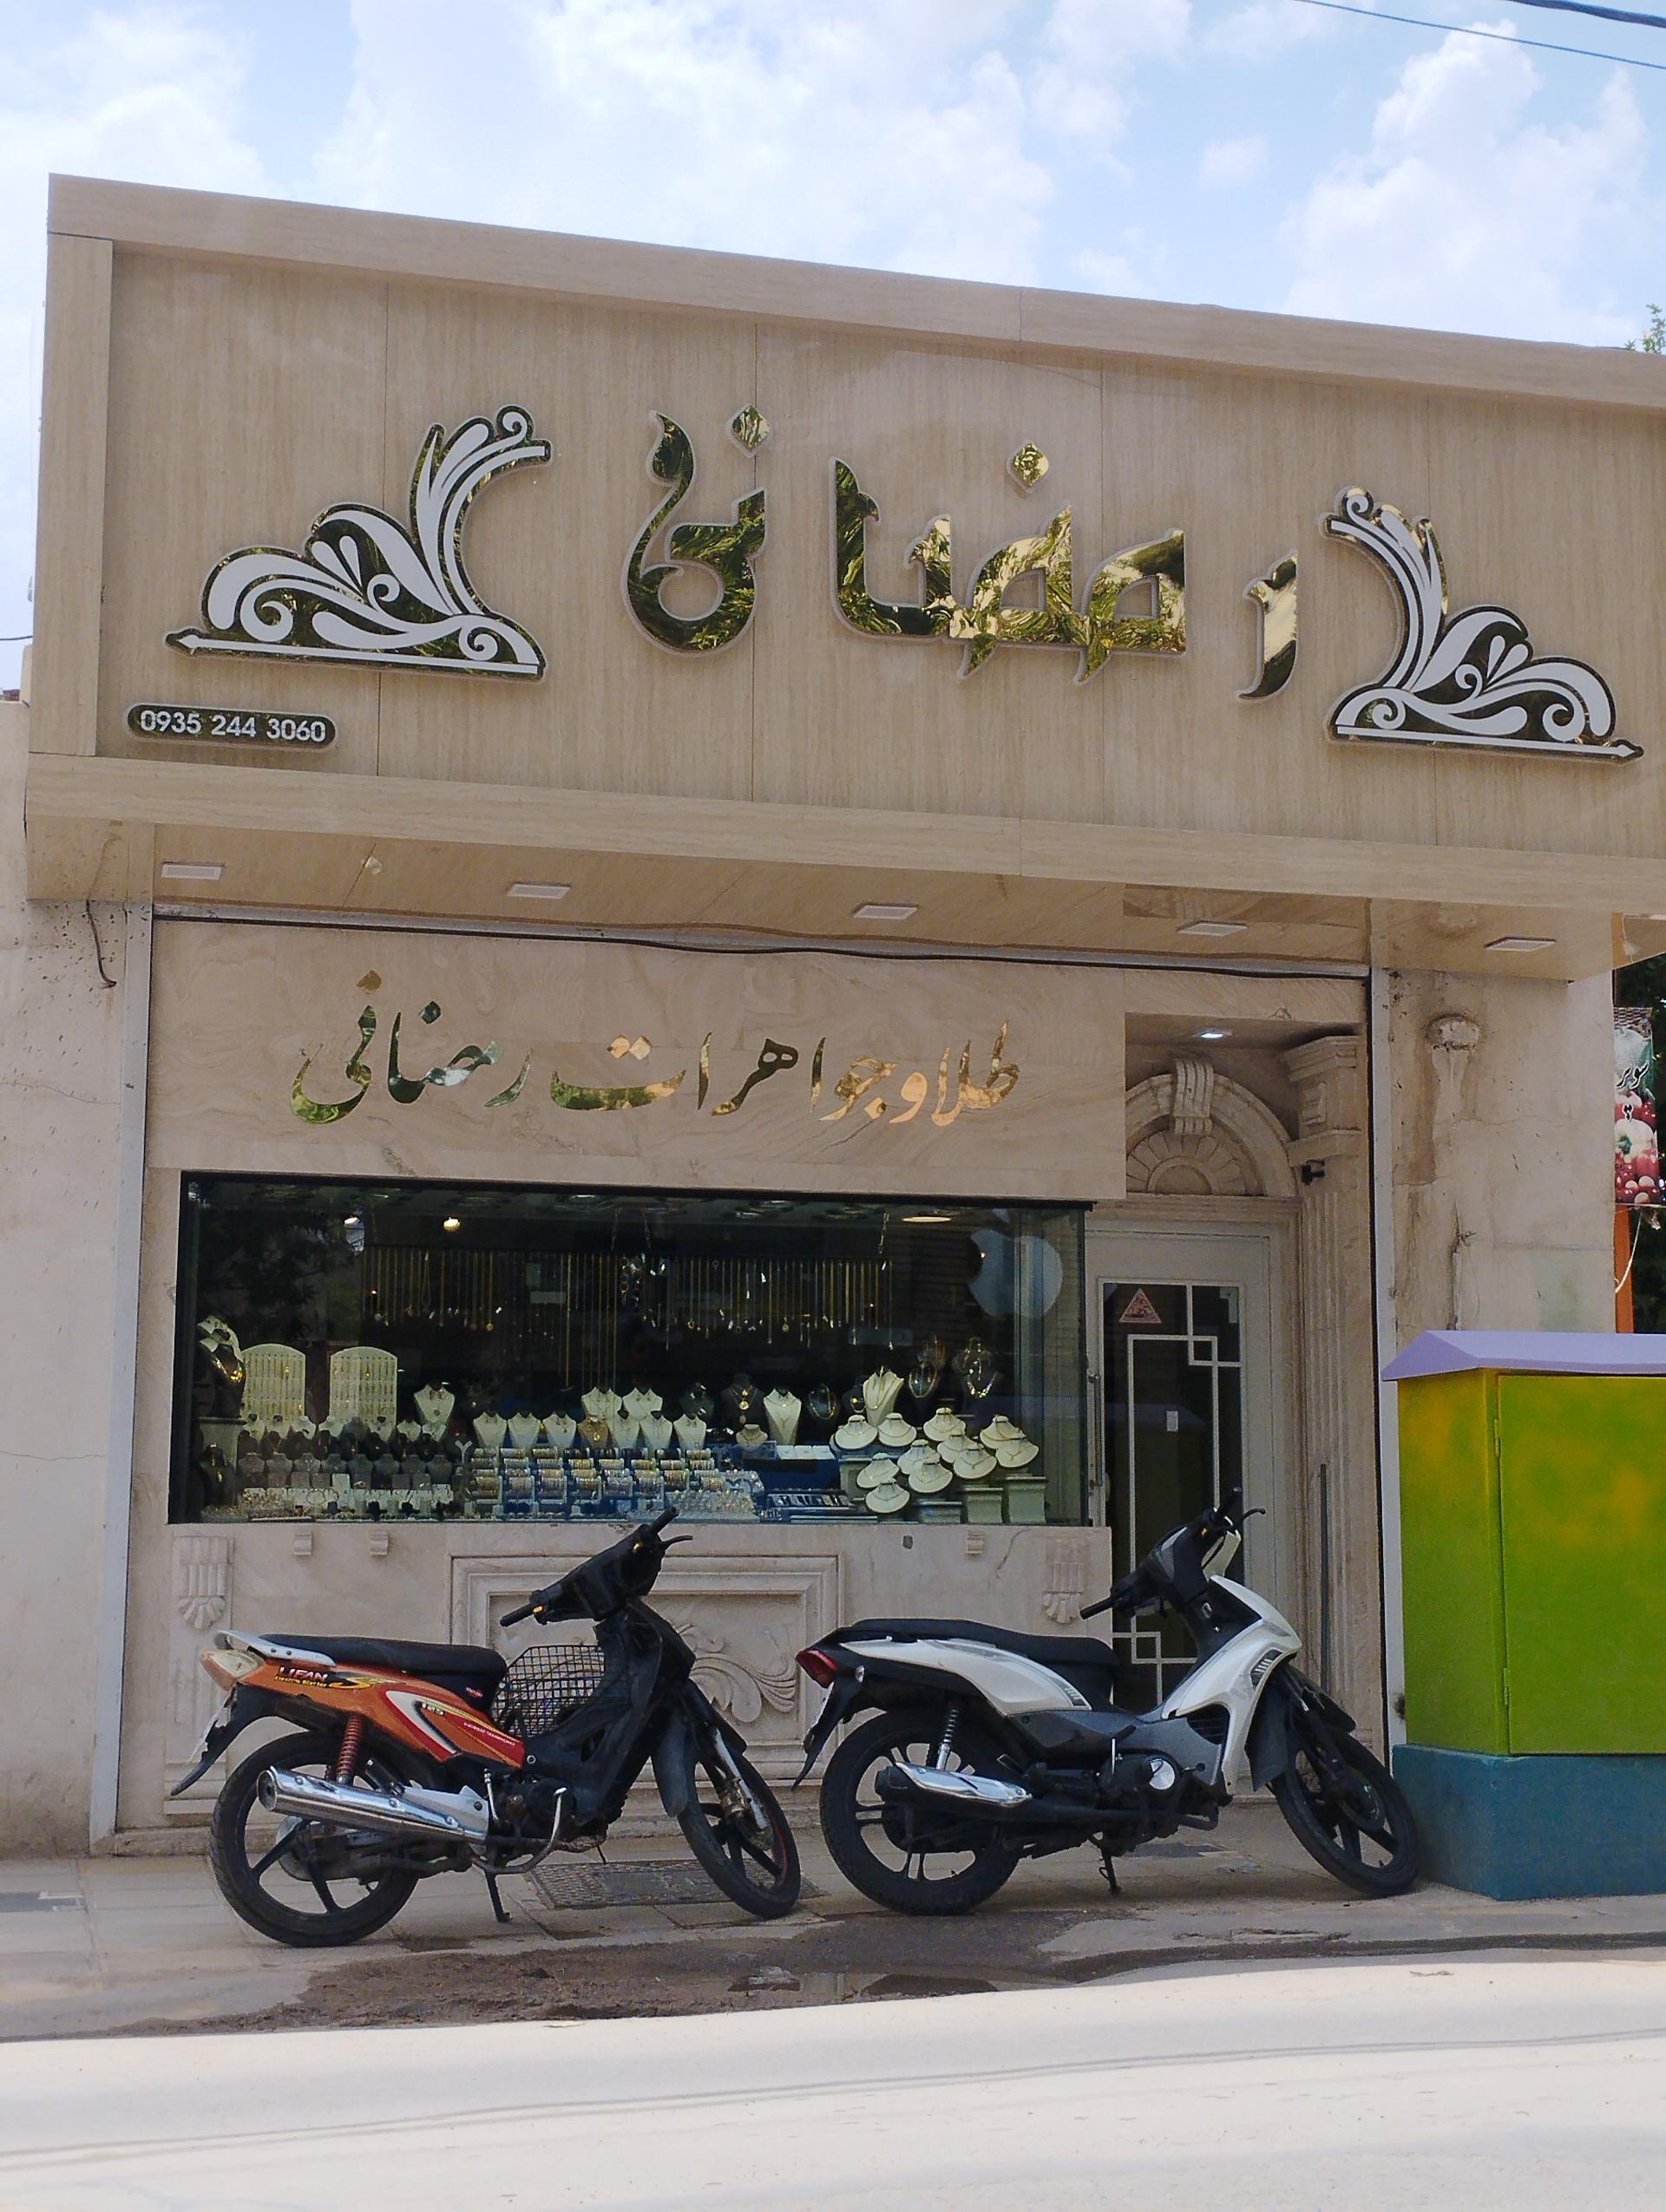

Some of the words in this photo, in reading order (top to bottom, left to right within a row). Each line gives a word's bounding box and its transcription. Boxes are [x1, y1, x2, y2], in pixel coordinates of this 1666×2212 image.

[622, 403, 1299, 702] رمضانی
[141, 710, 201, 734] 0935
[212, 715, 256, 737] 244
[267, 718, 326, 743] 3060
[291, 969, 535, 1124] رمضانی
[550, 1031, 898, 1122] جواهرات
[931, 1020, 1020, 1126] طلا
[889, 1071, 928, 1124] و
[279, 1666, 328, 1681] LIFAN
